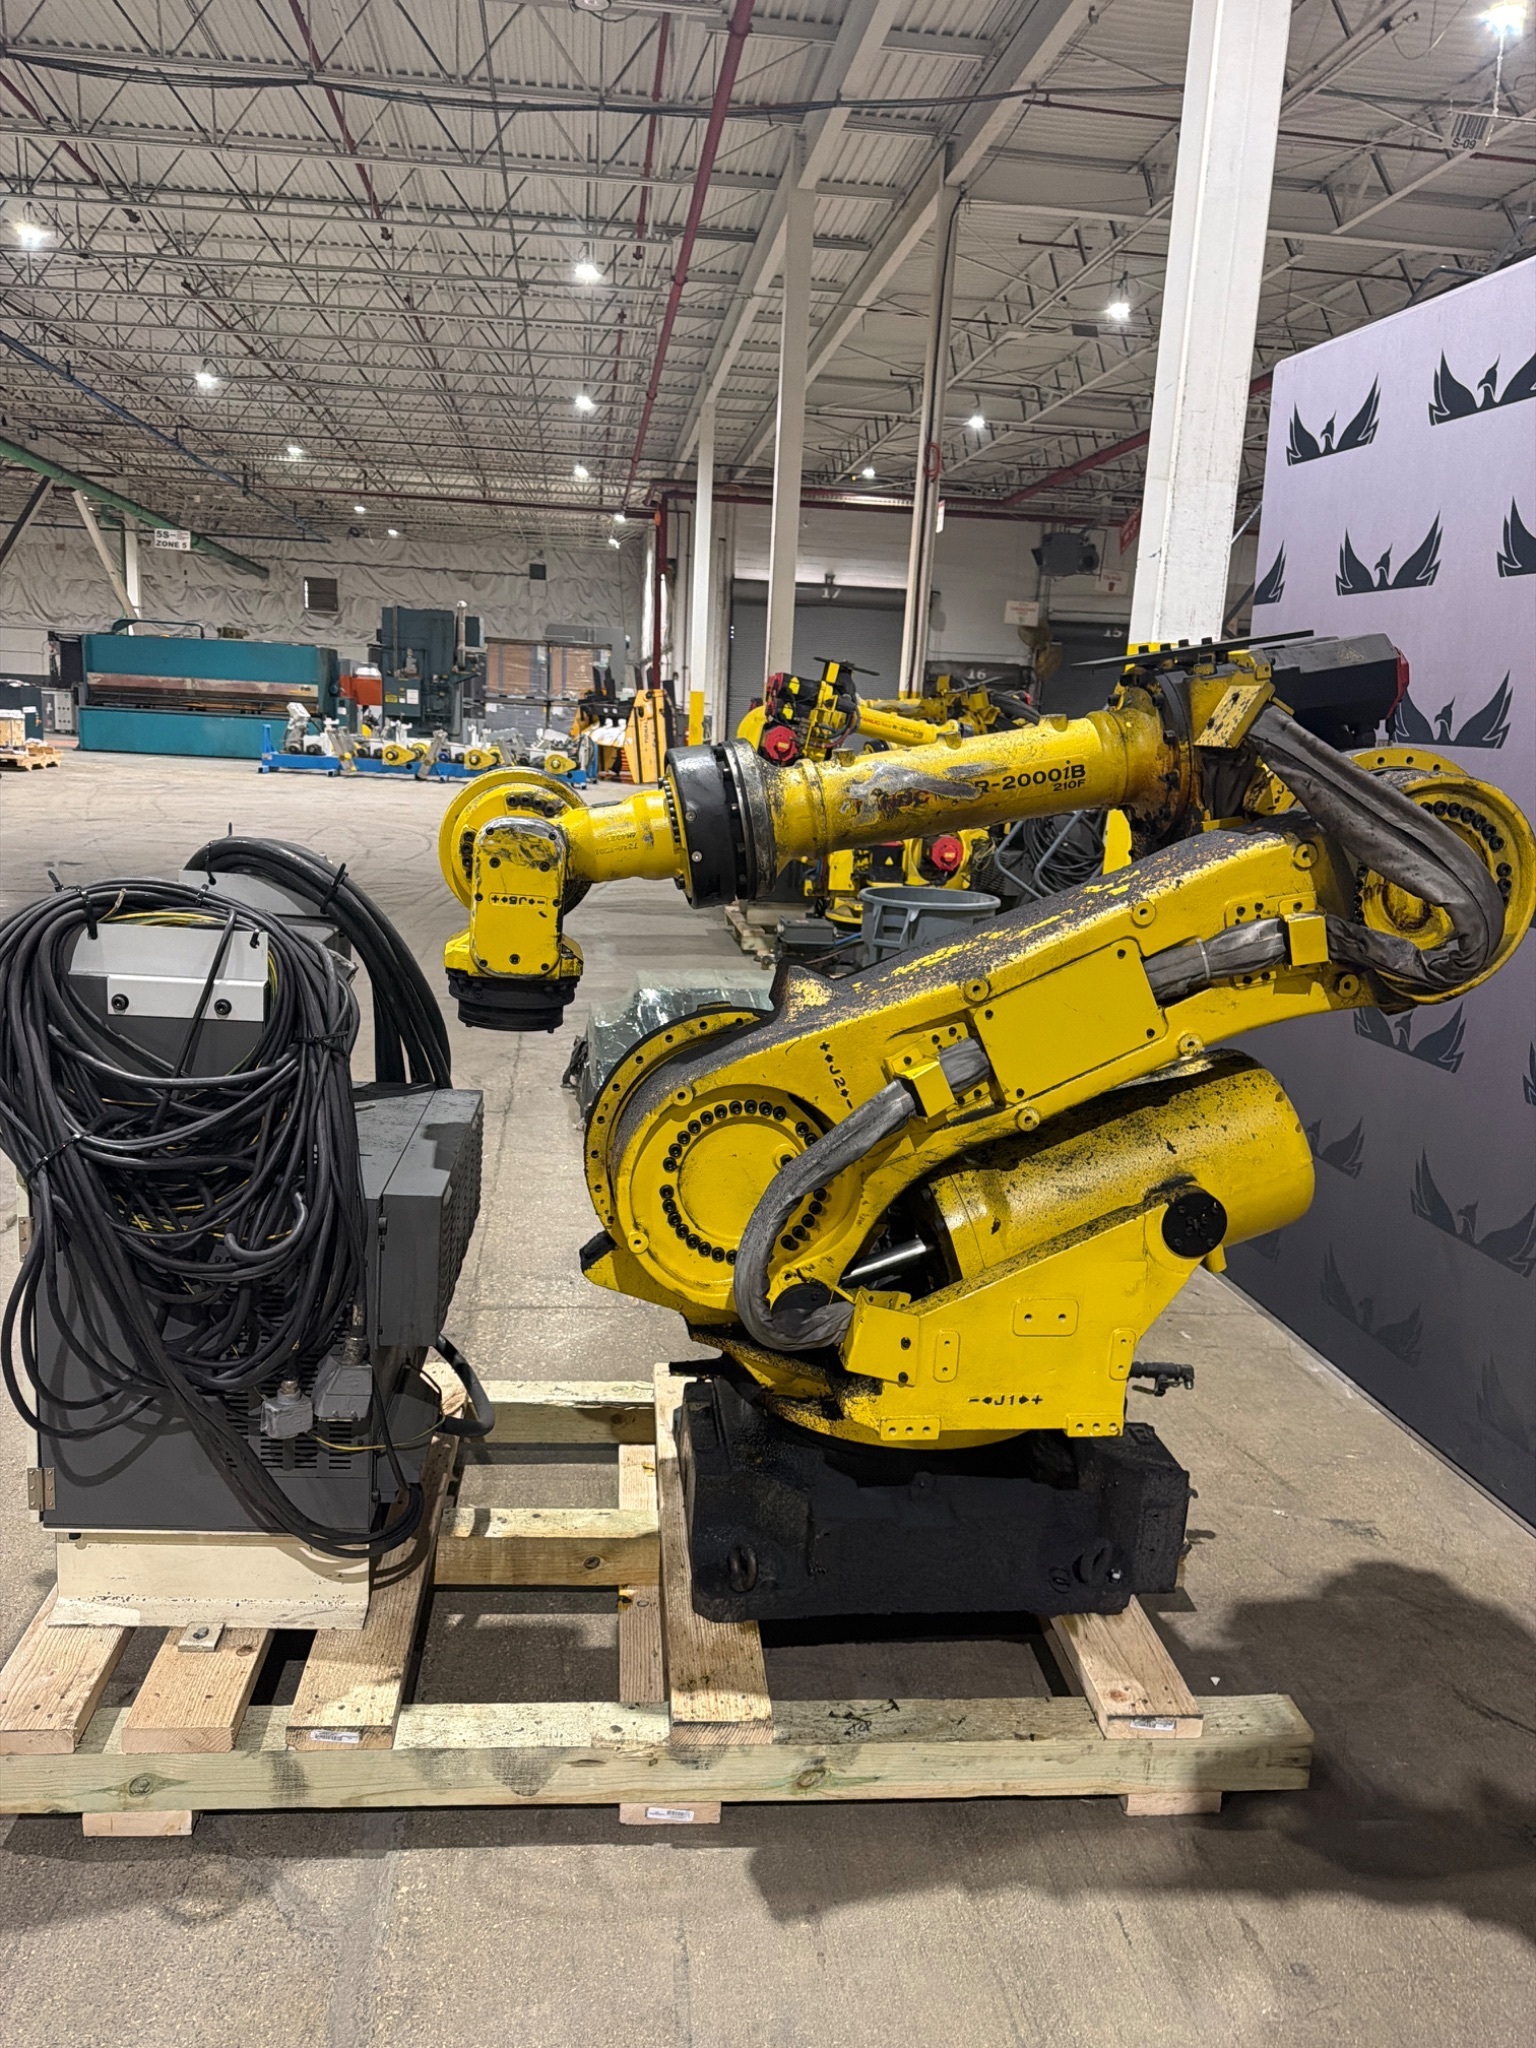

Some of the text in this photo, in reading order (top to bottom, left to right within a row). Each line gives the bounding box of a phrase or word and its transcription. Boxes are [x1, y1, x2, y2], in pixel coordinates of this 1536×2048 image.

[1452, 138, 1477, 150] S-09
[156, 540, 180, 548] ZONE
[967, 669, 987, 680] 16
[1053, 778, 1086, 791] 210F
